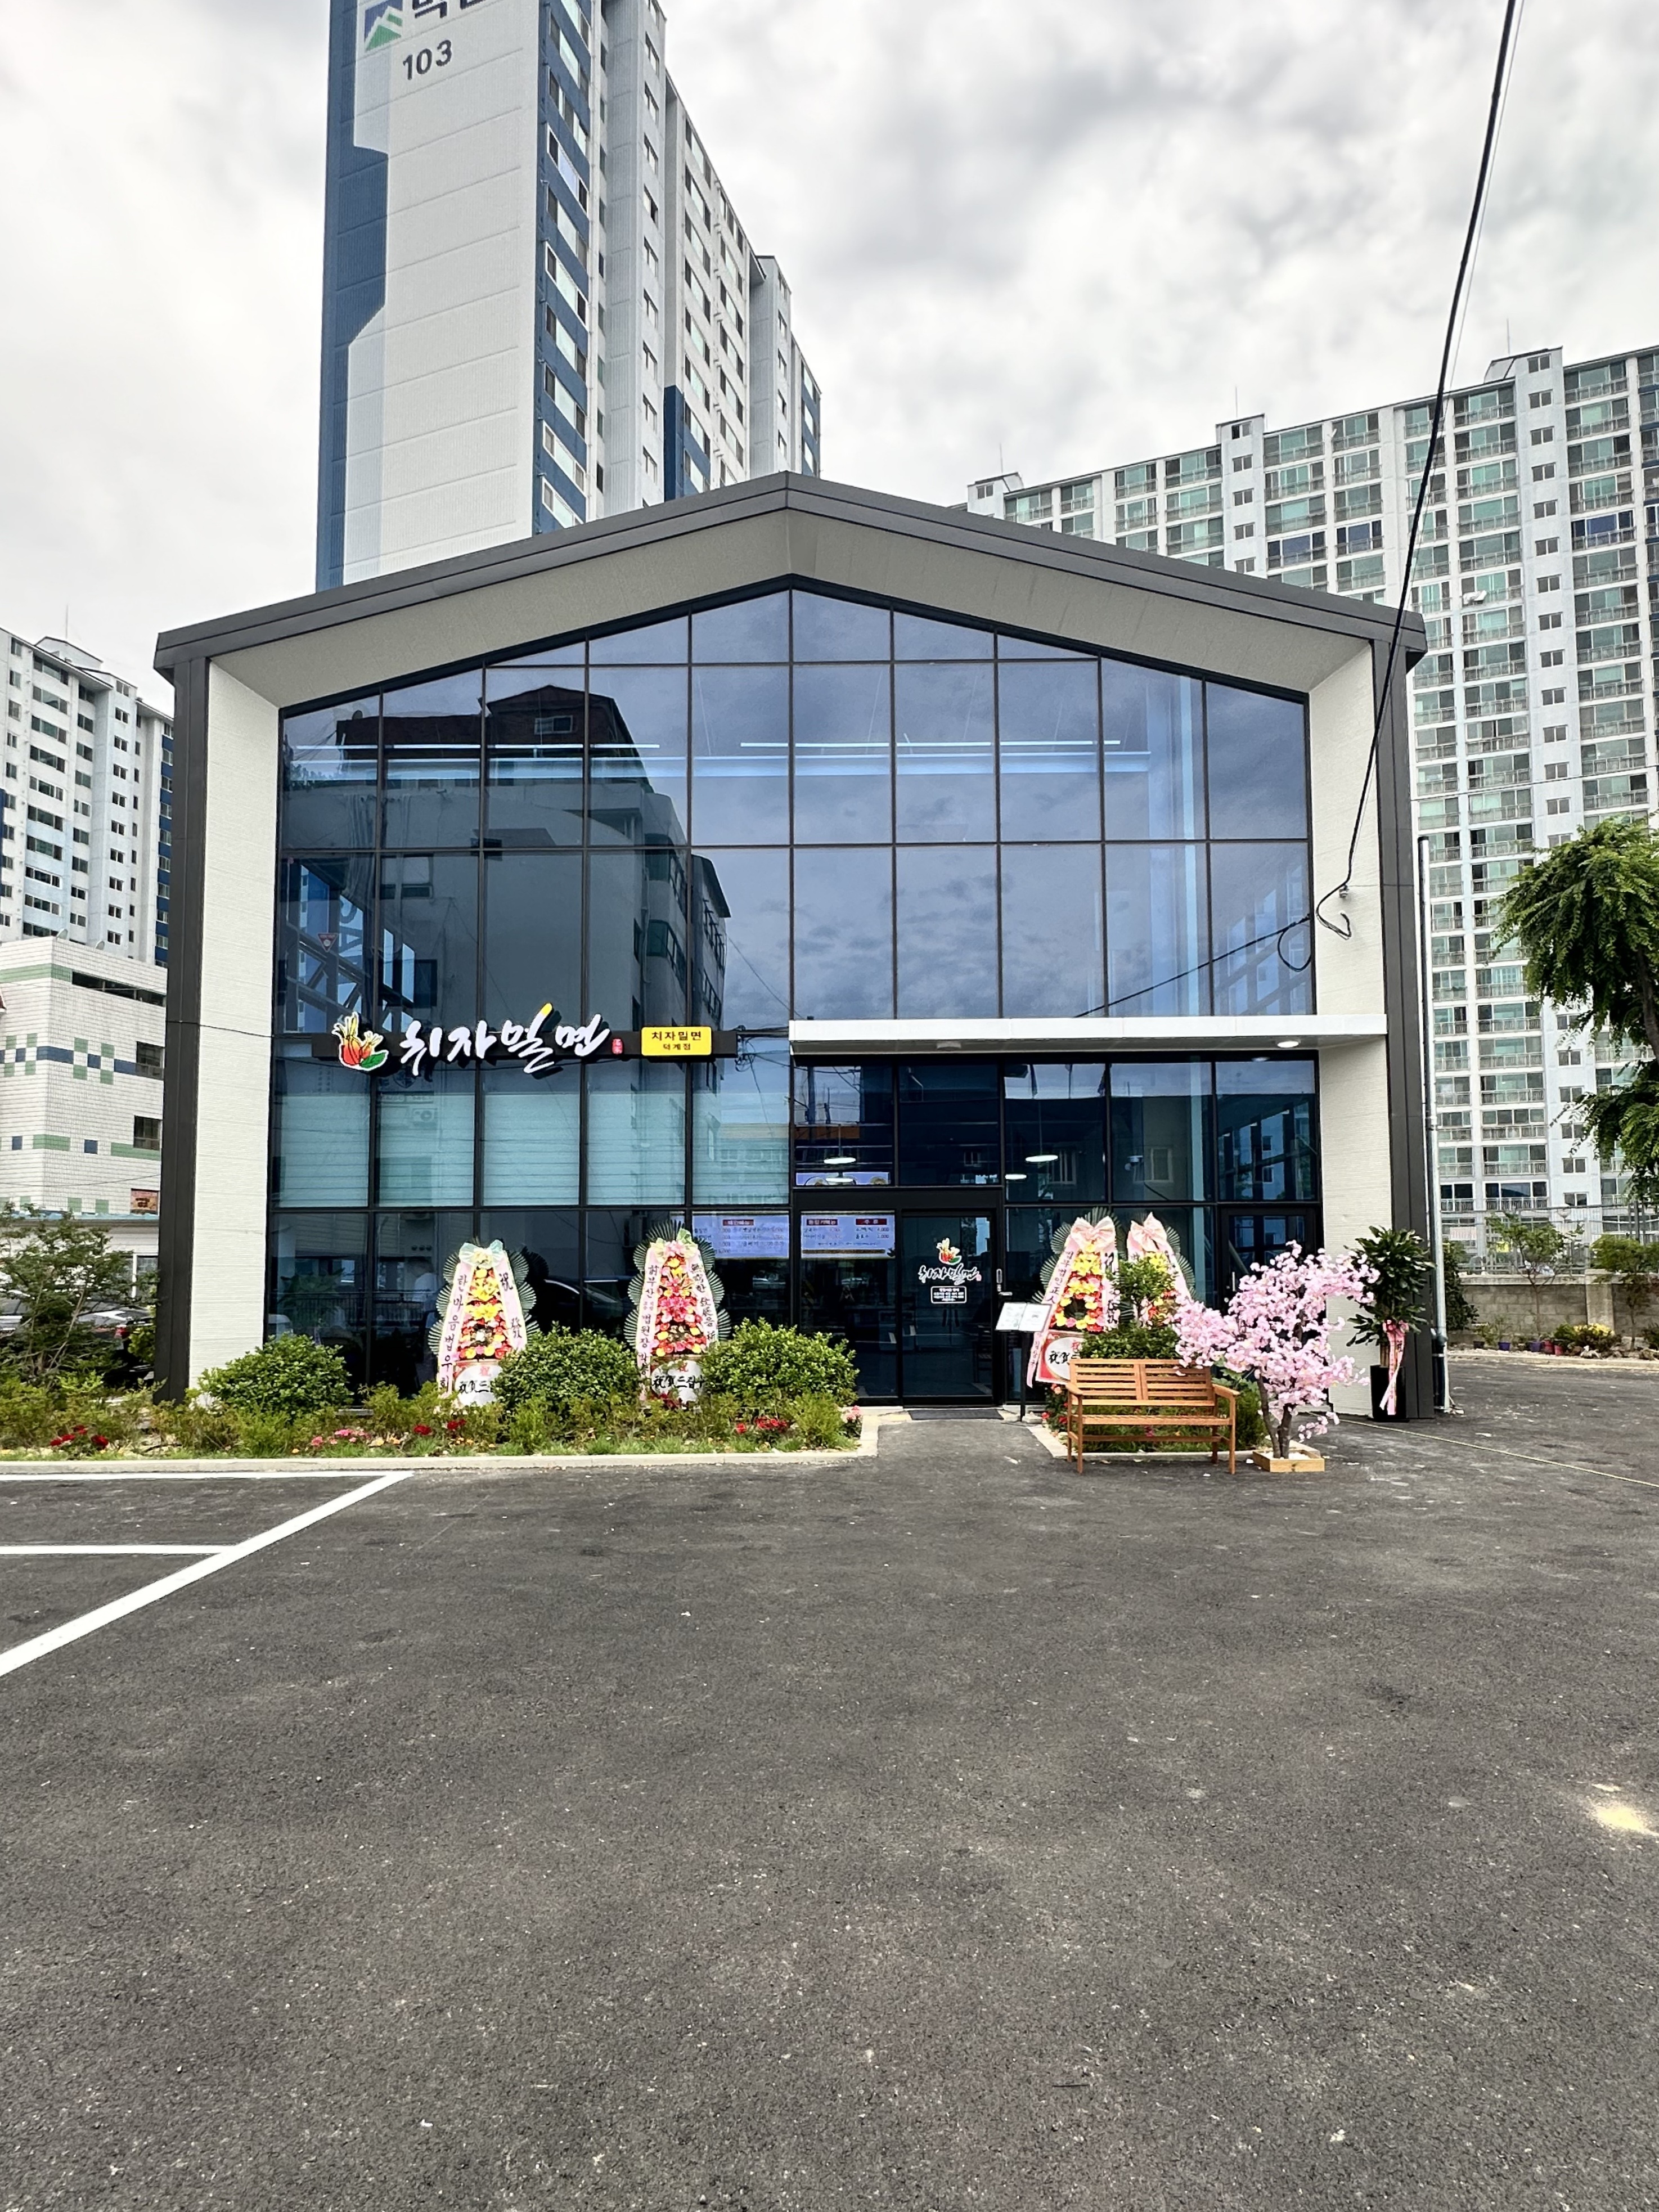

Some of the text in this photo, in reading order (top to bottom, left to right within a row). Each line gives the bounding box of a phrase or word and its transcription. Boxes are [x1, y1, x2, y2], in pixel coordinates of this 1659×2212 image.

[403, 40, 452, 80] 103
[399, 1003, 610, 1076] 치자밀면
[651, 1031, 701, 1041] 치자밀면
